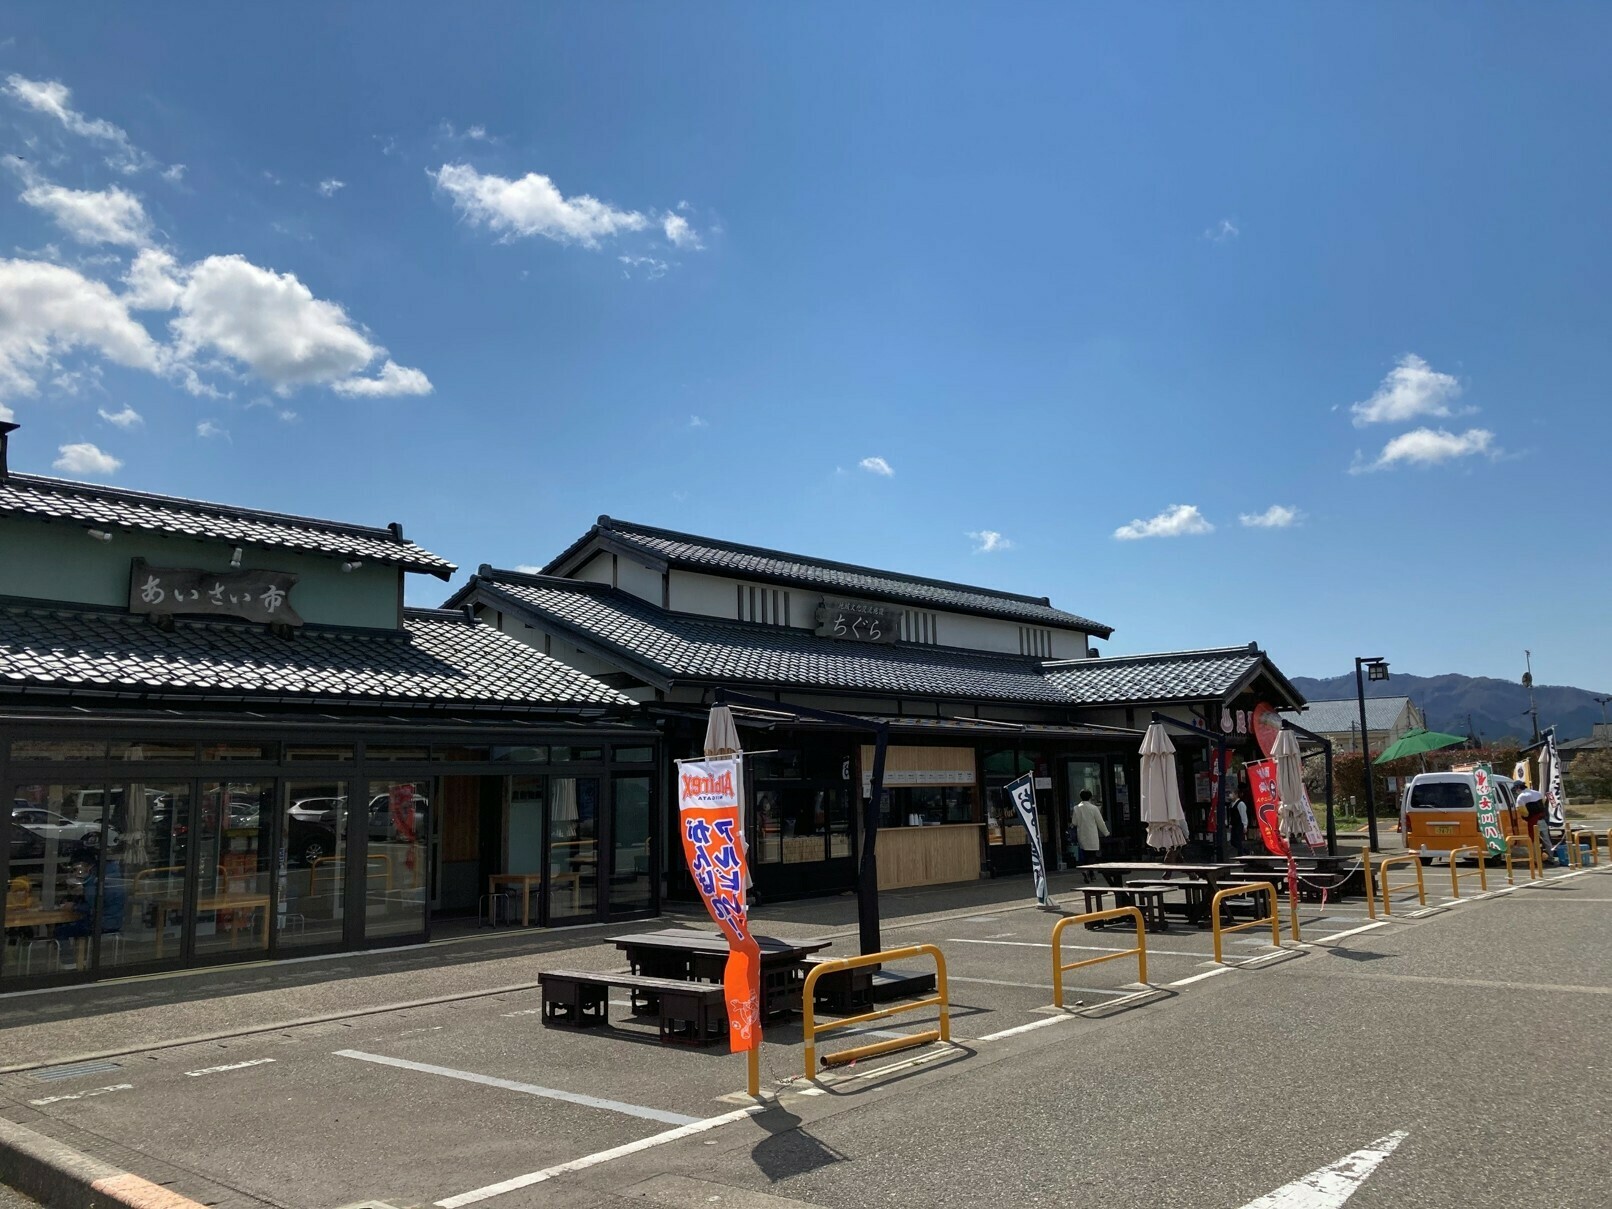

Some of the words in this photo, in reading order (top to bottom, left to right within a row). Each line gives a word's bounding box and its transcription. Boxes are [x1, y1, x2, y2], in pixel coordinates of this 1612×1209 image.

[140, 574, 286, 613] あいさい市
[832, 613, 882, 641] ちぐら
